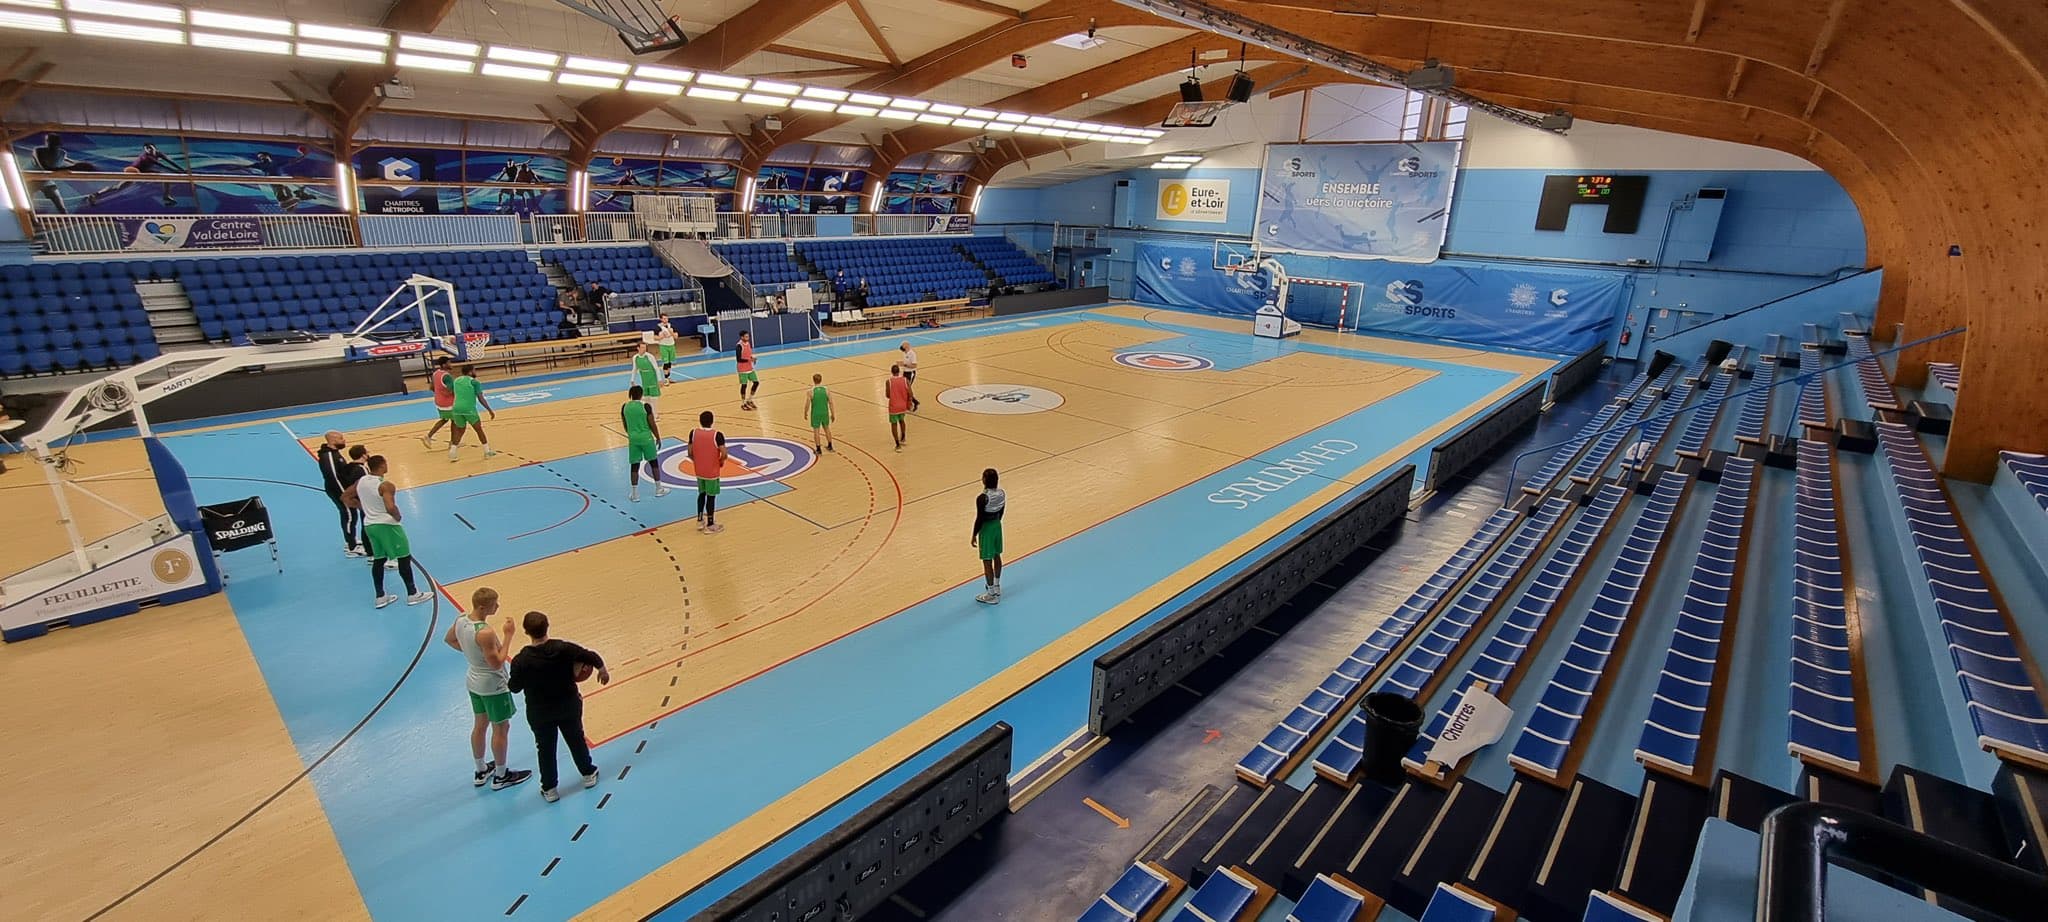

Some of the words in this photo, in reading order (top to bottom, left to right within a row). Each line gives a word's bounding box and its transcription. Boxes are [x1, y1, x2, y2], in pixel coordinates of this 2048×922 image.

[1191, 187, 1220, 198] Eure-
[1322, 182, 1380, 194] ENSEMBLE
[1190, 197, 1225, 209] et-Loir
[1306, 197, 1331, 207] vers
[1332, 198, 1346, 207] la
[1346, 198, 1394, 209] victoire
[211, 220, 256, 230] Centre-
[192, 230, 212, 241] Val
[213, 230, 228, 240] de
[229, 229, 259, 239] Loire
[1253, 290, 1295, 304] SPS
[1405, 305, 1456, 319] SPORTS
[162, 376, 194, 393] MARTY
[1207, 439, 1359, 510] CHARTRES
[215, 521, 266, 540] SPALDING
[43, 576, 142, 606] FEUILLETTE
[1442, 703, 1476, 741] Chartres
